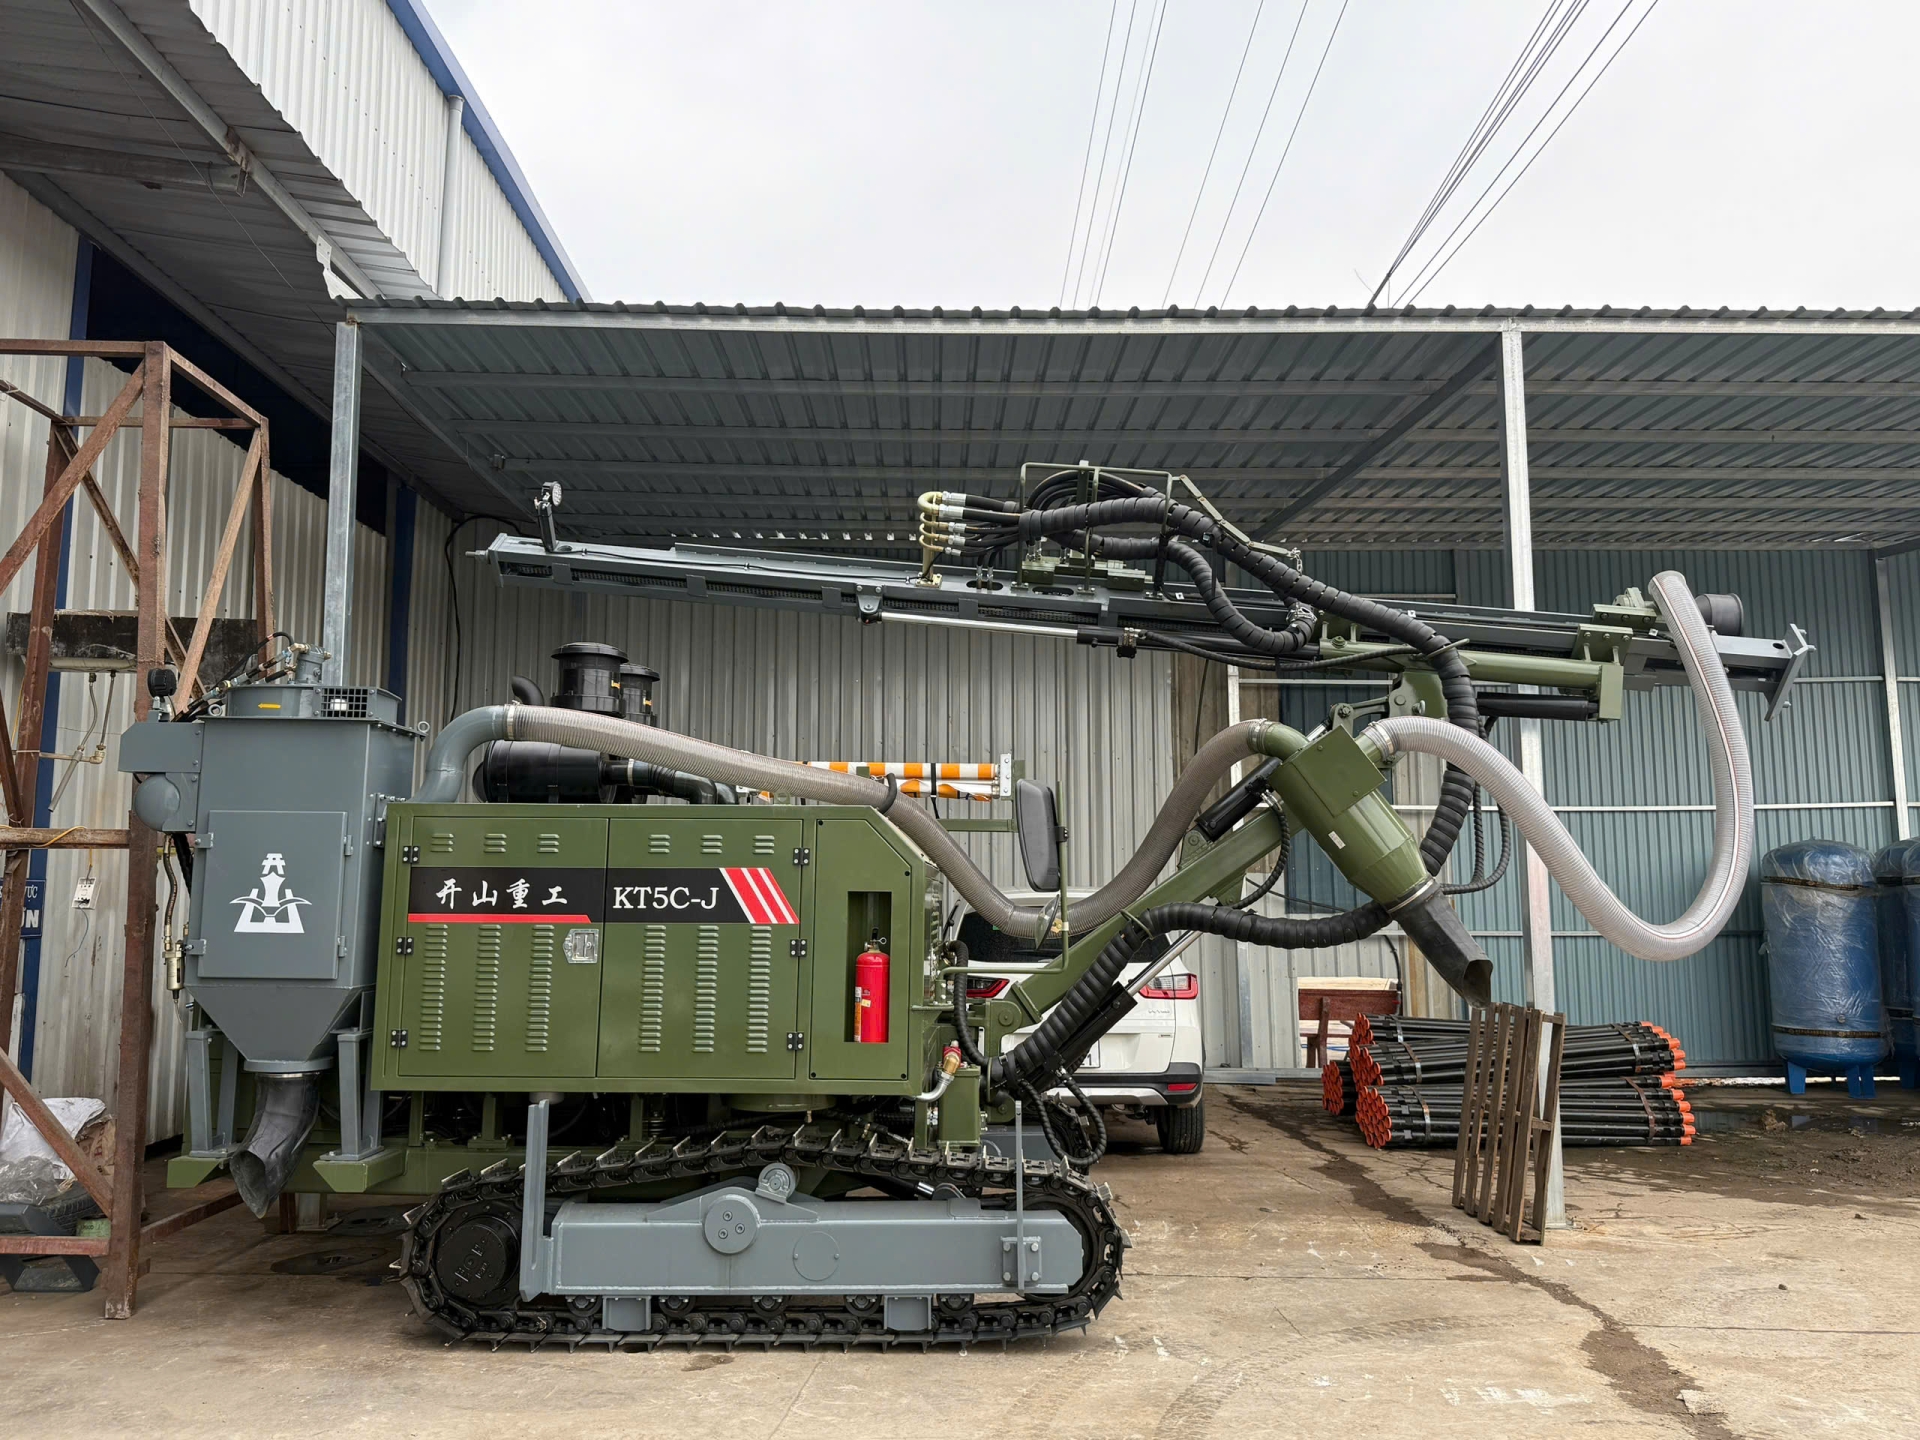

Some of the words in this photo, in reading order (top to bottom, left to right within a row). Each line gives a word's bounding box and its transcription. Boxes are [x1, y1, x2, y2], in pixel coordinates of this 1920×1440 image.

[24, 884, 38, 902] ỰC
[436, 878, 567, 909] 开山重工
[612, 886, 720, 910] KT5C-J
